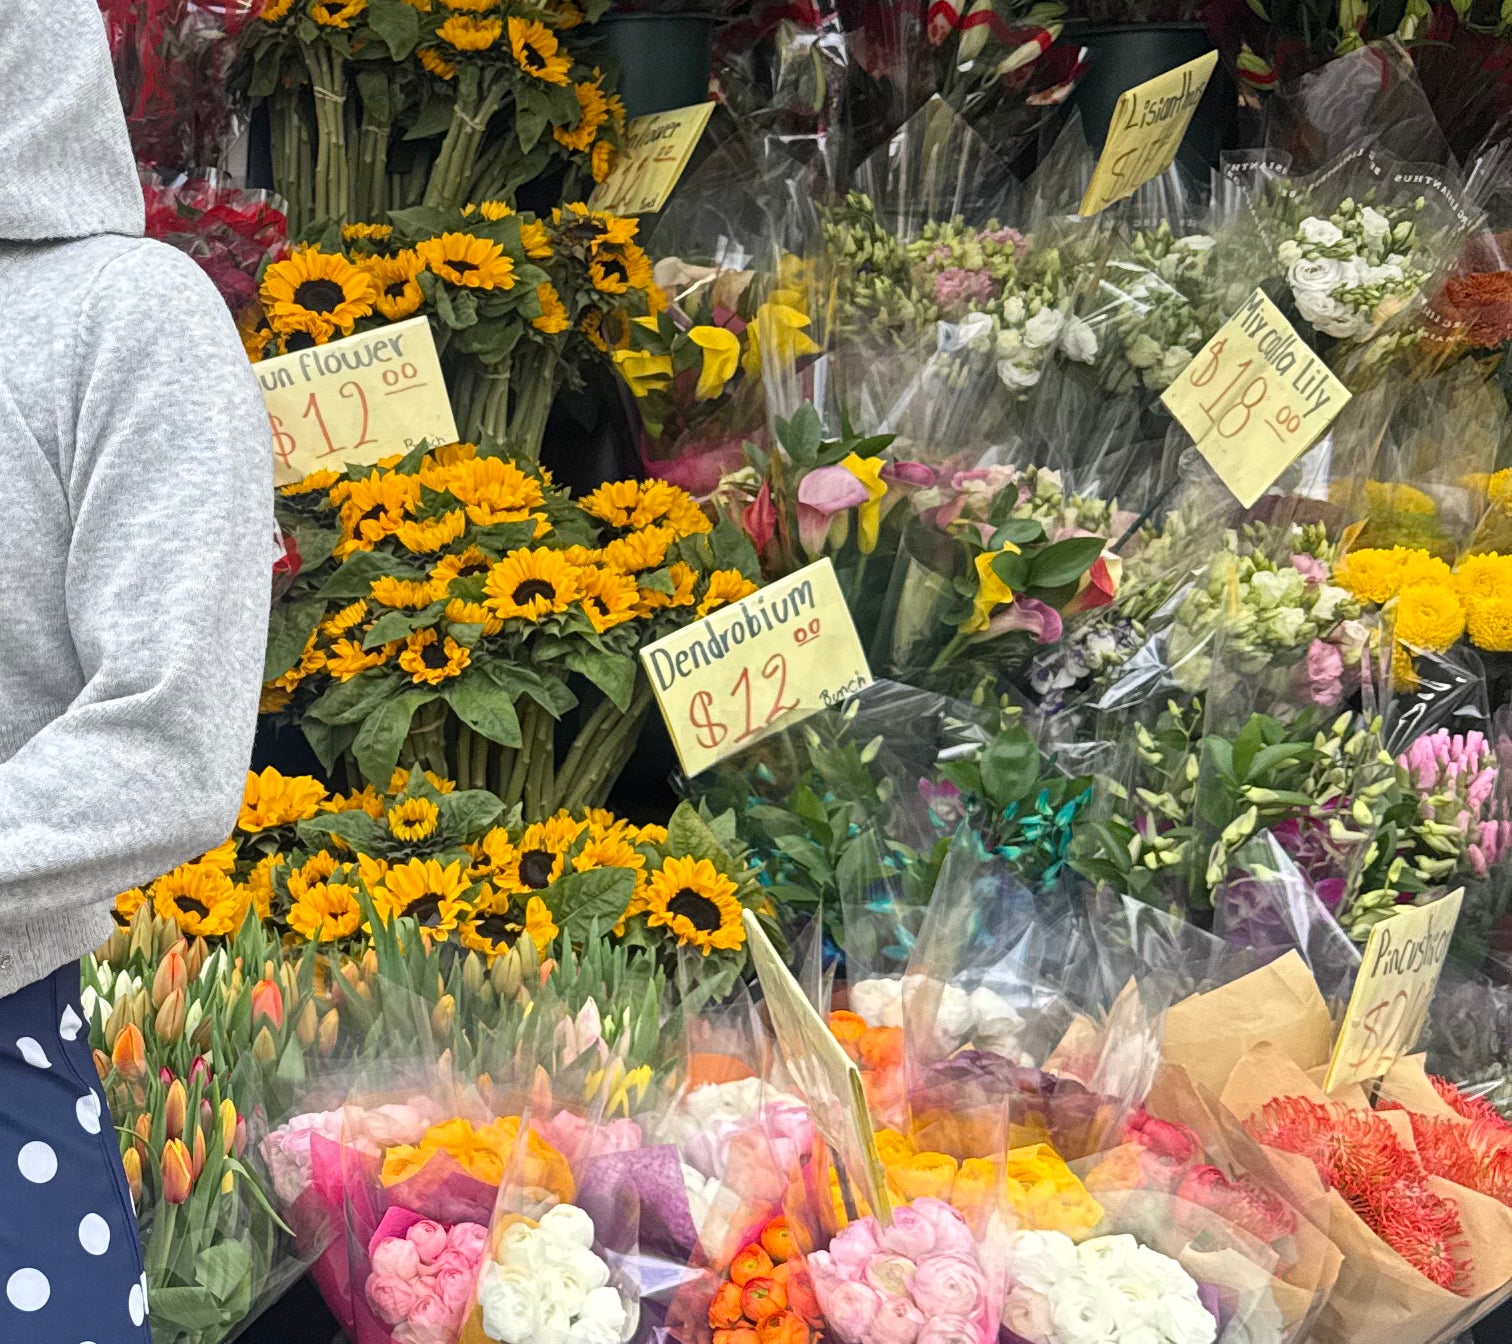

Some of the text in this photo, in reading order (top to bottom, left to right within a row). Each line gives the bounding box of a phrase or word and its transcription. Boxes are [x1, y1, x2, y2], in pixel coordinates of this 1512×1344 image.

[1231, 292, 1269, 339] Mix
[258, 333, 404, 392] un flower
[649, 580, 816, 692] Dendrobium
[688, 653, 800, 750] $12
